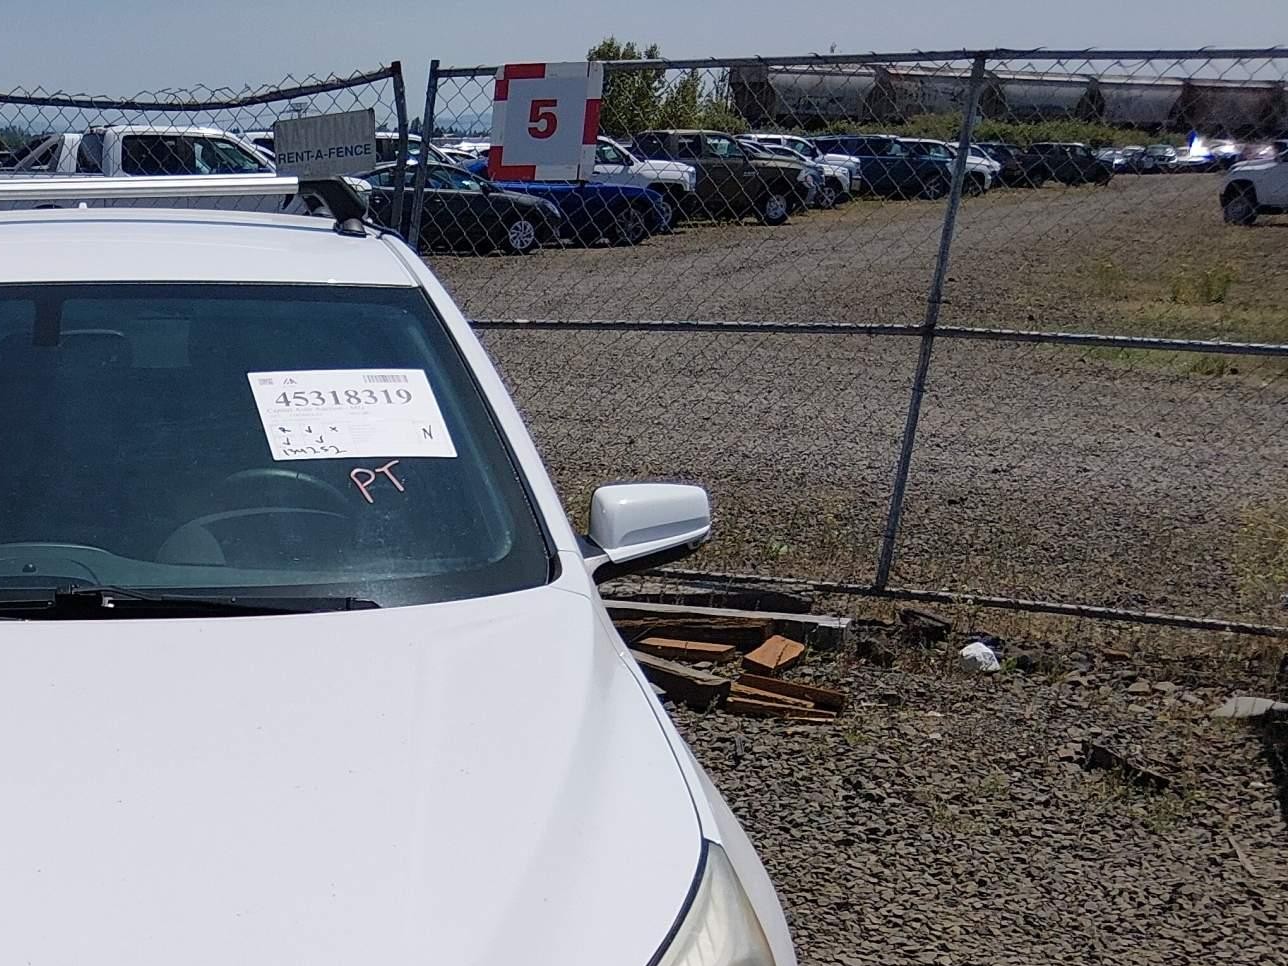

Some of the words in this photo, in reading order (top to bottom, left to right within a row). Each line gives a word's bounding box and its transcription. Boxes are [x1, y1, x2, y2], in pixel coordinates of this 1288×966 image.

[527, 99, 558, 139] 5
[278, 143, 372, 165] RENT-A-FENCE
[275, 388, 413, 407] 45318319
[350, 460, 405, 504] PT
